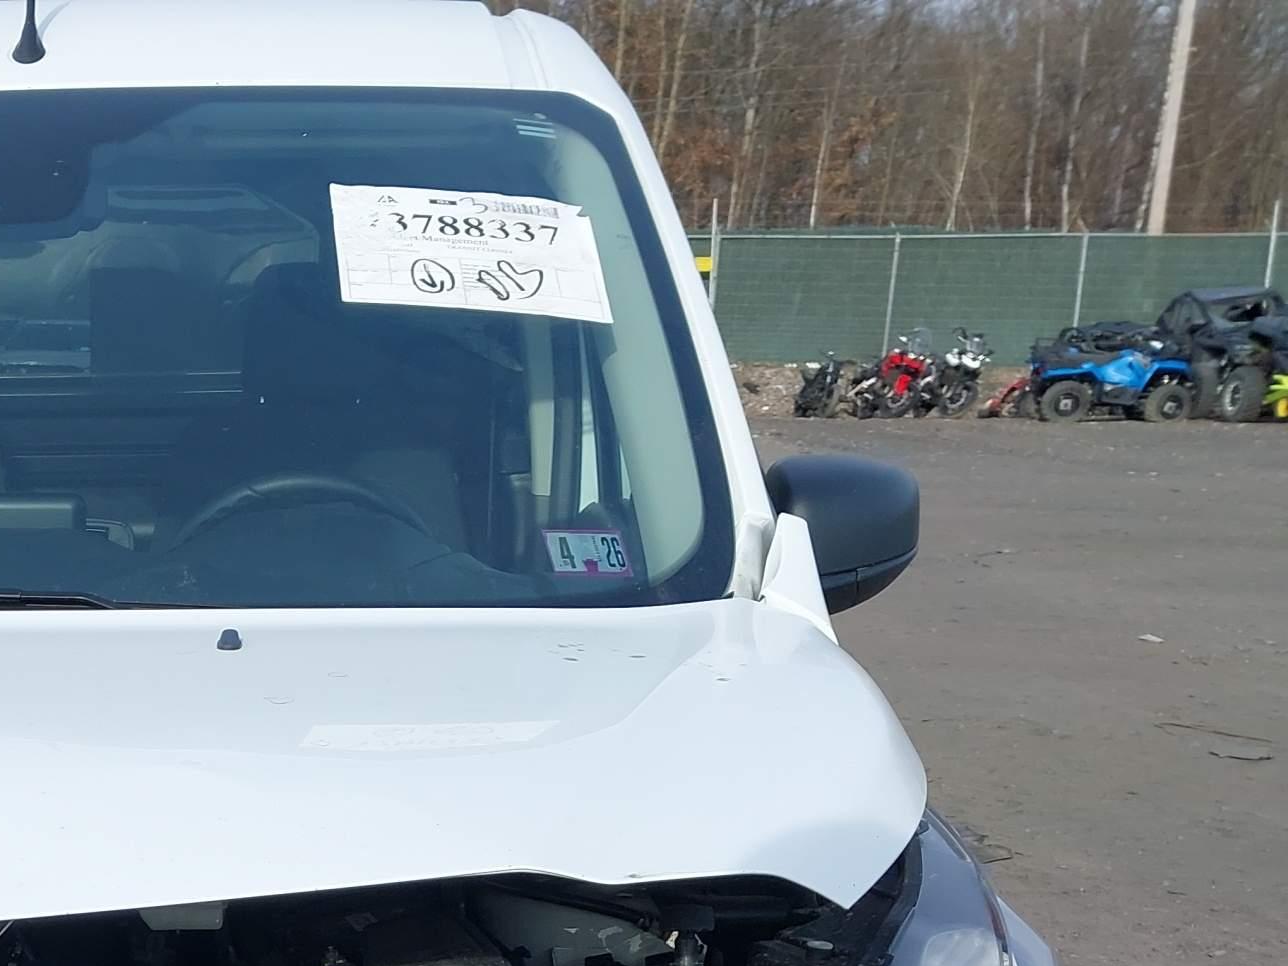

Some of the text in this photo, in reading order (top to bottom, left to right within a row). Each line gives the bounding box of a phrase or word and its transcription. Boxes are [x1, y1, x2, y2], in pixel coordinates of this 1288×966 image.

[369, 211, 559, 245] 3788337
[558, 536, 577, 569] 4
[600, 536, 626, 568] 26
